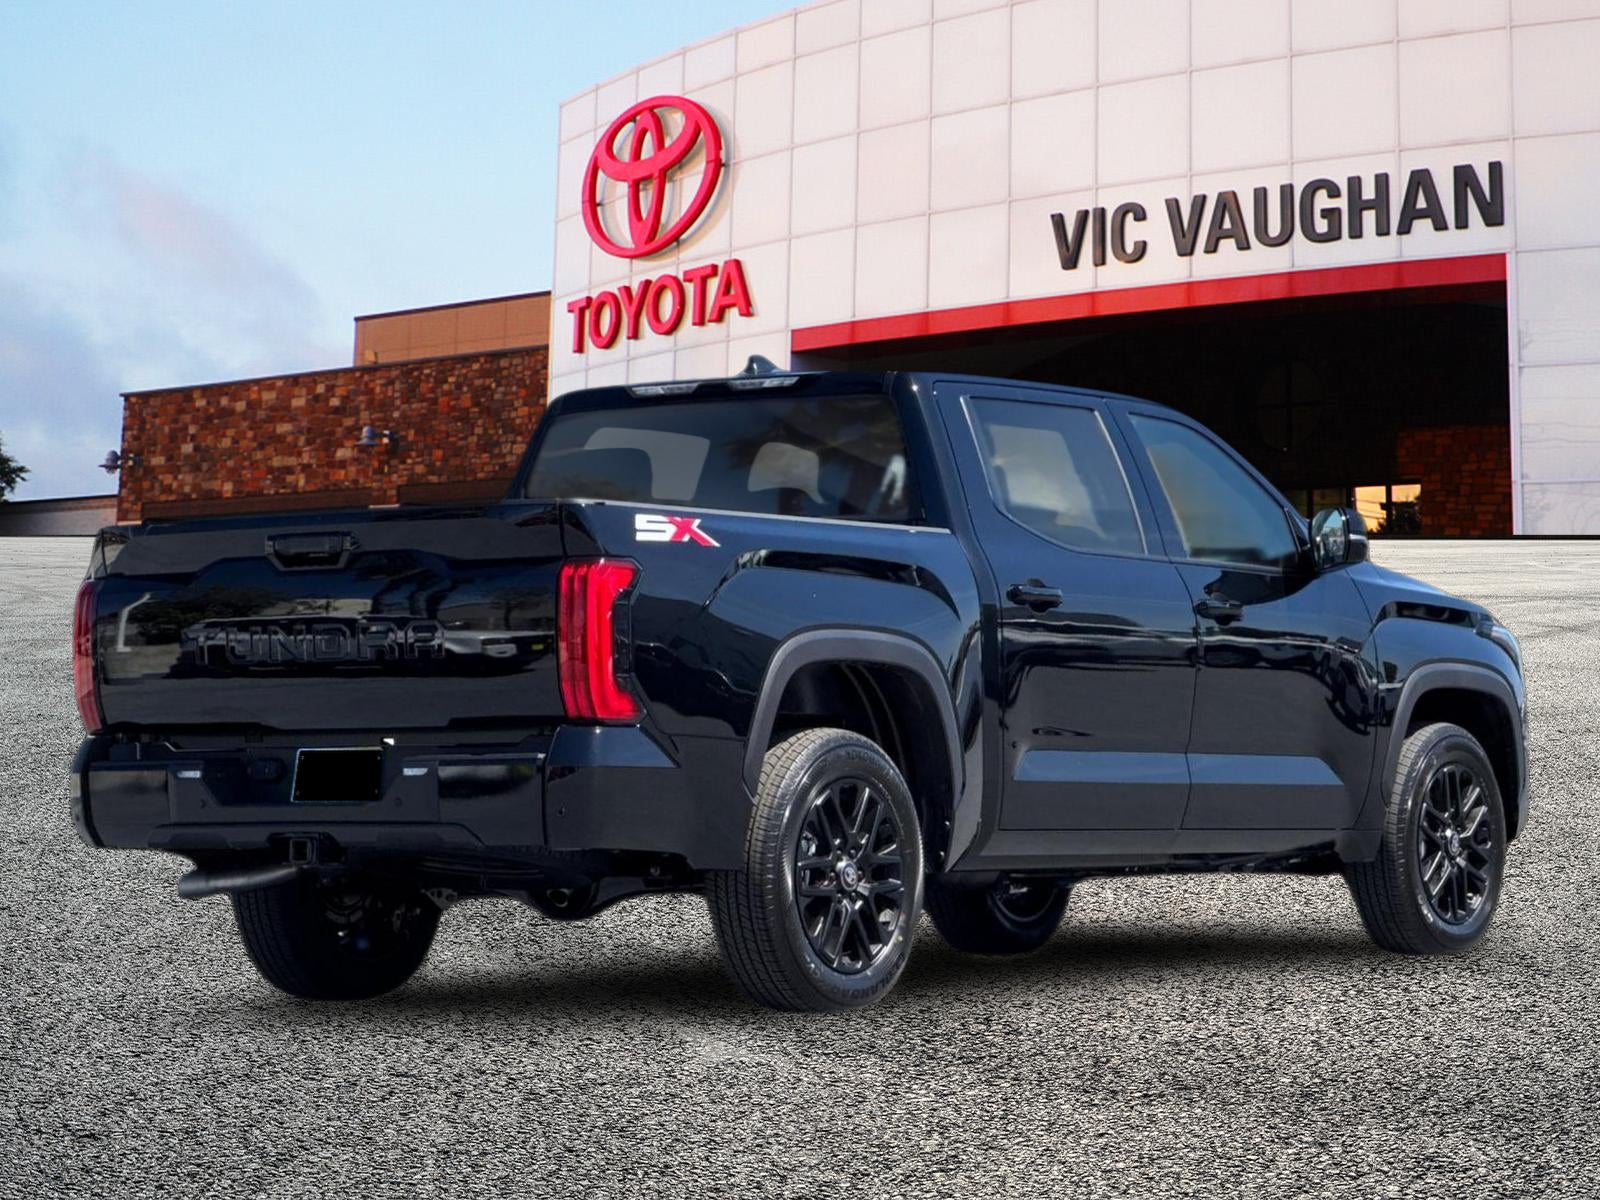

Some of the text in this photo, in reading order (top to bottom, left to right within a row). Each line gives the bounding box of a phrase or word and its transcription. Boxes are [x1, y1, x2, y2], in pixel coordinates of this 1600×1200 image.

[1051, 161, 1505, 270] VIC VAUGHAN
[567, 259, 754, 353] TOYOTA
[183, 620, 446, 665] TUNDRA
